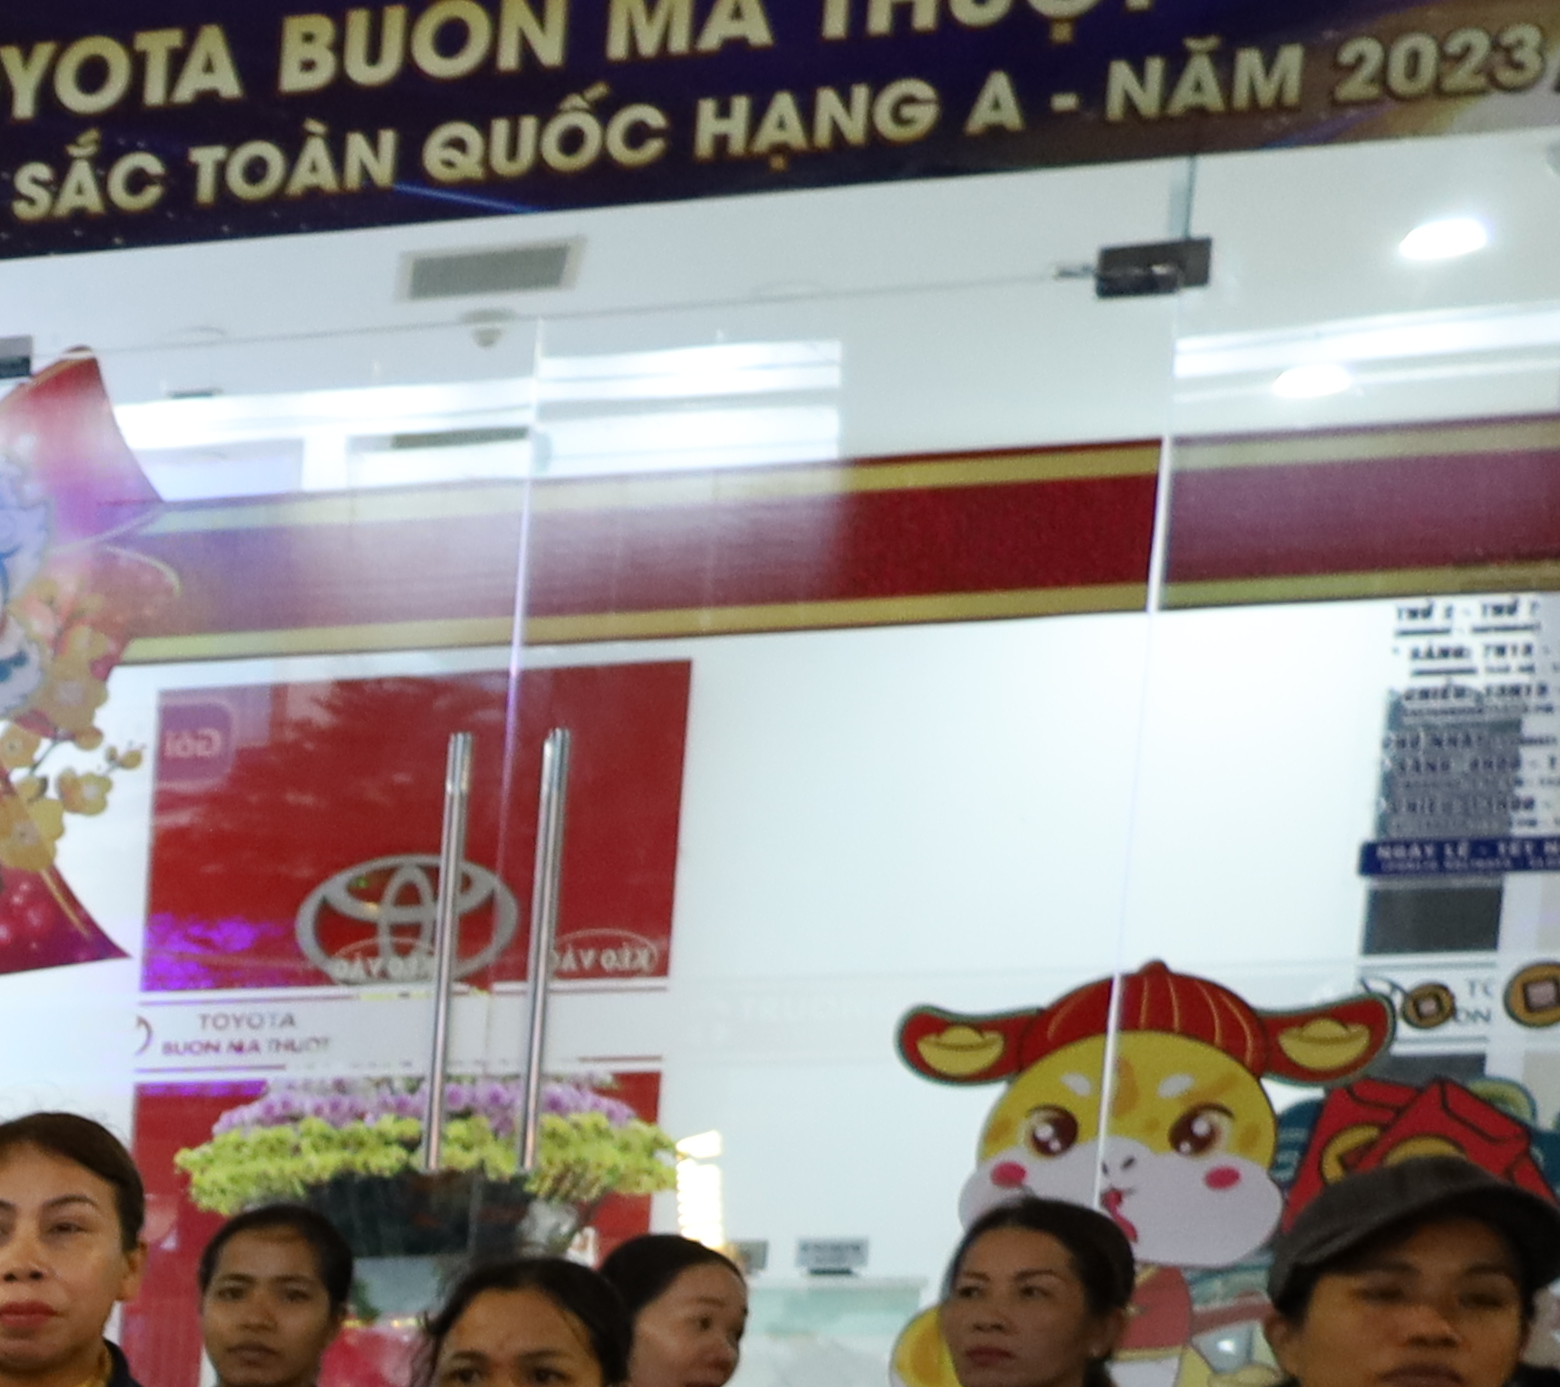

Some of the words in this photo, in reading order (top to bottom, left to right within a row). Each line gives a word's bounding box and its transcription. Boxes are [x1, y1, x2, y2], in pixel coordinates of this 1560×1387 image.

[277, 0, 570, 94] BUON
[605, 0, 774, 62] MA
[12, 127, 167, 221] SẮC
[189, 117, 398, 206] TOÀN
[422, 82, 669, 184] QUỐC
[693, 77, 941, 173] HẠNG
[963, 70, 1025, 136] A
[1105, 34, 1305, 123] NĂM
[199, 1013, 297, 1030] TOYOTA
